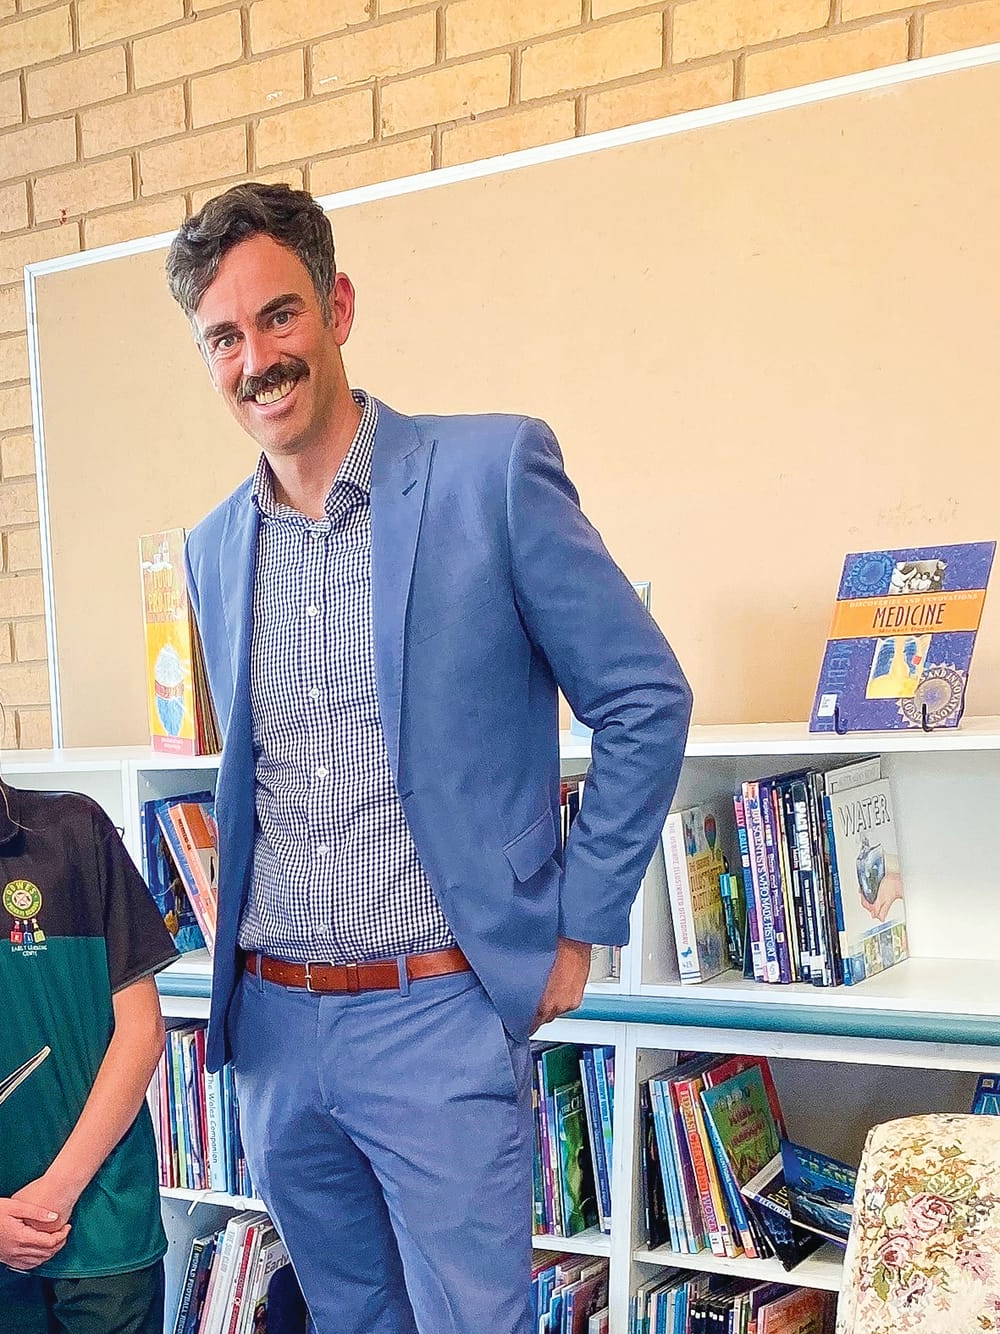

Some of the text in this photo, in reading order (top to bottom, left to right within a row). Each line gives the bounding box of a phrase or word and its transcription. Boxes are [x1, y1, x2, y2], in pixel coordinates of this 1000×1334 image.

[872, 602, 947, 629] MEDICINE
[794, 801, 809, 831] SPACE
[838, 793, 891, 838] WATER
[752, 825, 769, 873] SCIENTISTS
[798, 831, 813, 871] ODYSSEY
[759, 873, 771, 897] WHO
[762, 897, 773, 920] MADE
[764, 920, 778, 959] HISTORY
[208, 1093, 216, 1119] Wales
[210, 1120, 219, 1165] Companion
[191, 1252, 201, 1279] WORLD
[182, 1278, 195, 1309] FOOTBALL
